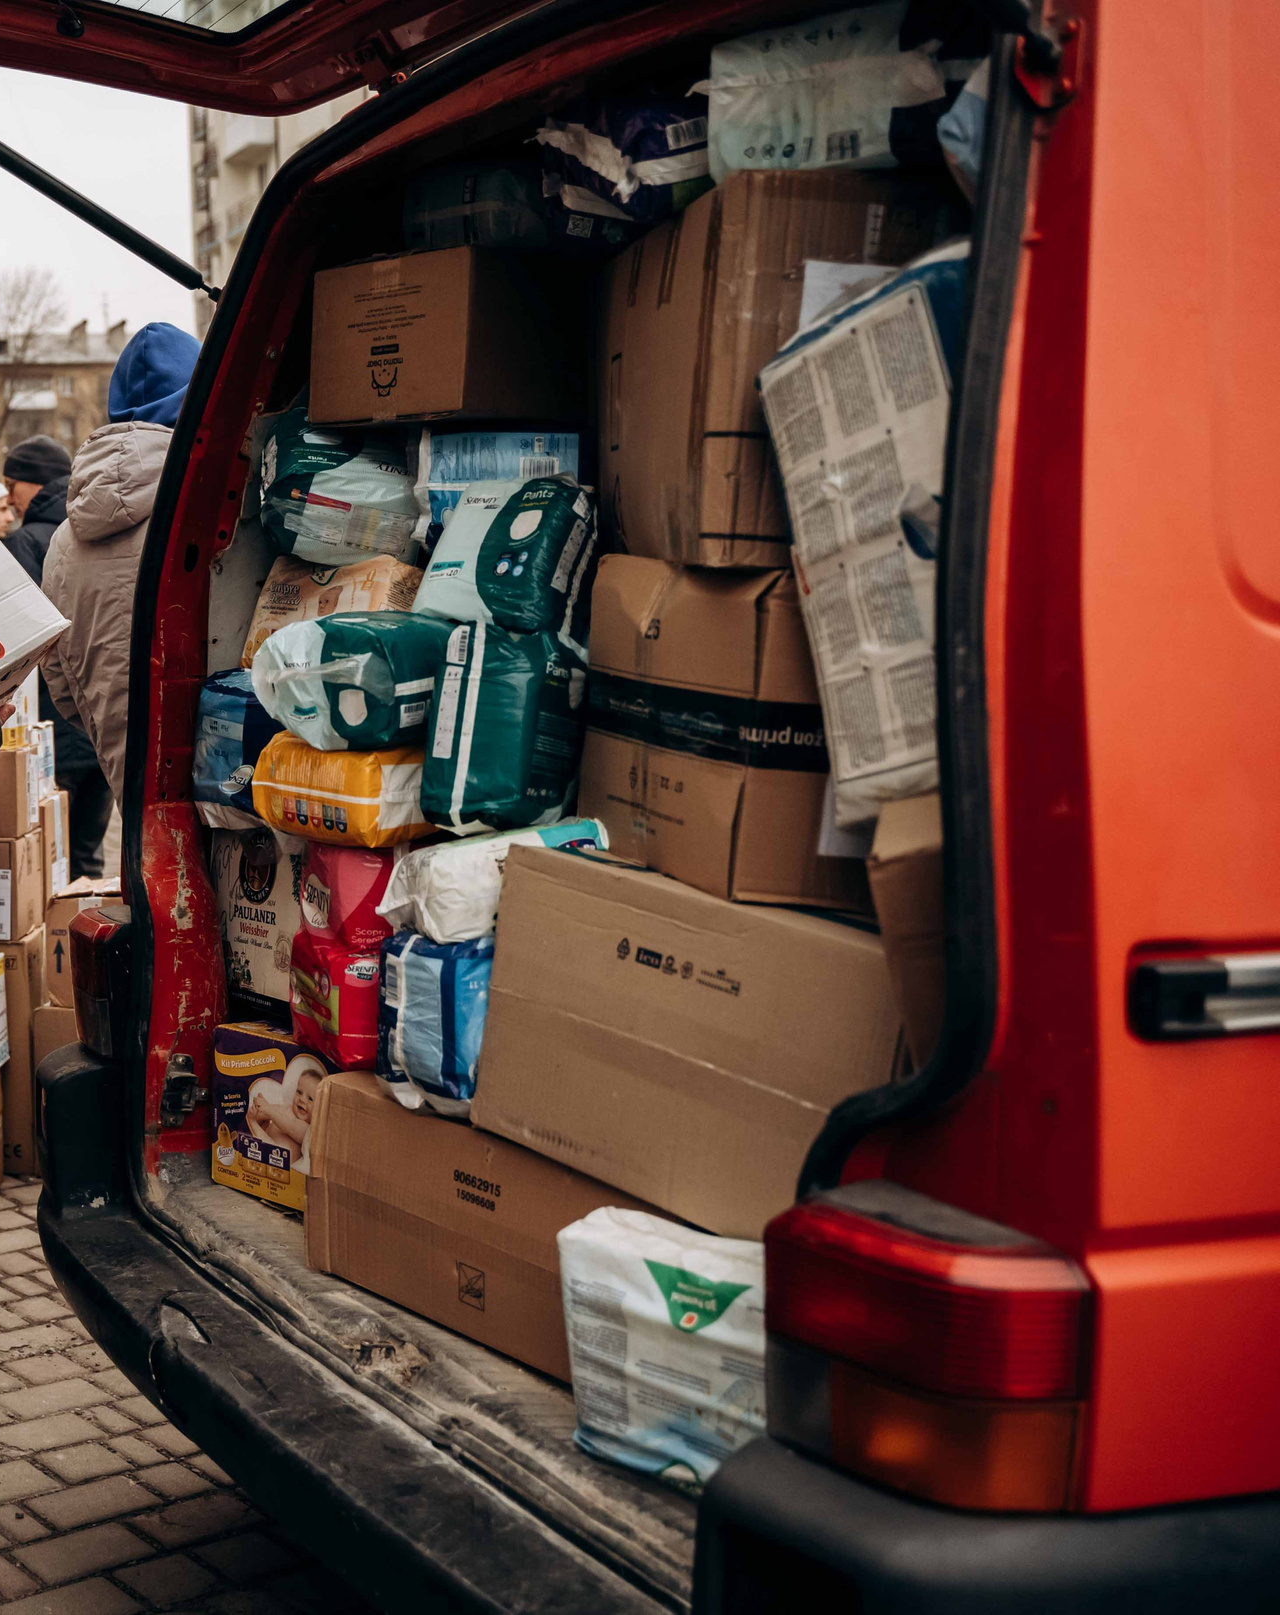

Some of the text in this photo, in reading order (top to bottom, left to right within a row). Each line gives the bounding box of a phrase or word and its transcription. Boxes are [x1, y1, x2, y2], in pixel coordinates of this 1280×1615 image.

[523, 490, 556, 500] Pants
[739, 725, 791, 748] prime
[228, 774, 246, 786] TENA
[234, 904, 277, 926] PAULANER
[239, 921, 269, 938] Weissbier
[355, 928, 386, 936] Scopri
[347, 964, 380, 973] SERENITY
[221, 1055, 276, 1069] Kit Prime Coccole
[453, 1169, 501, 1198] 90662915
